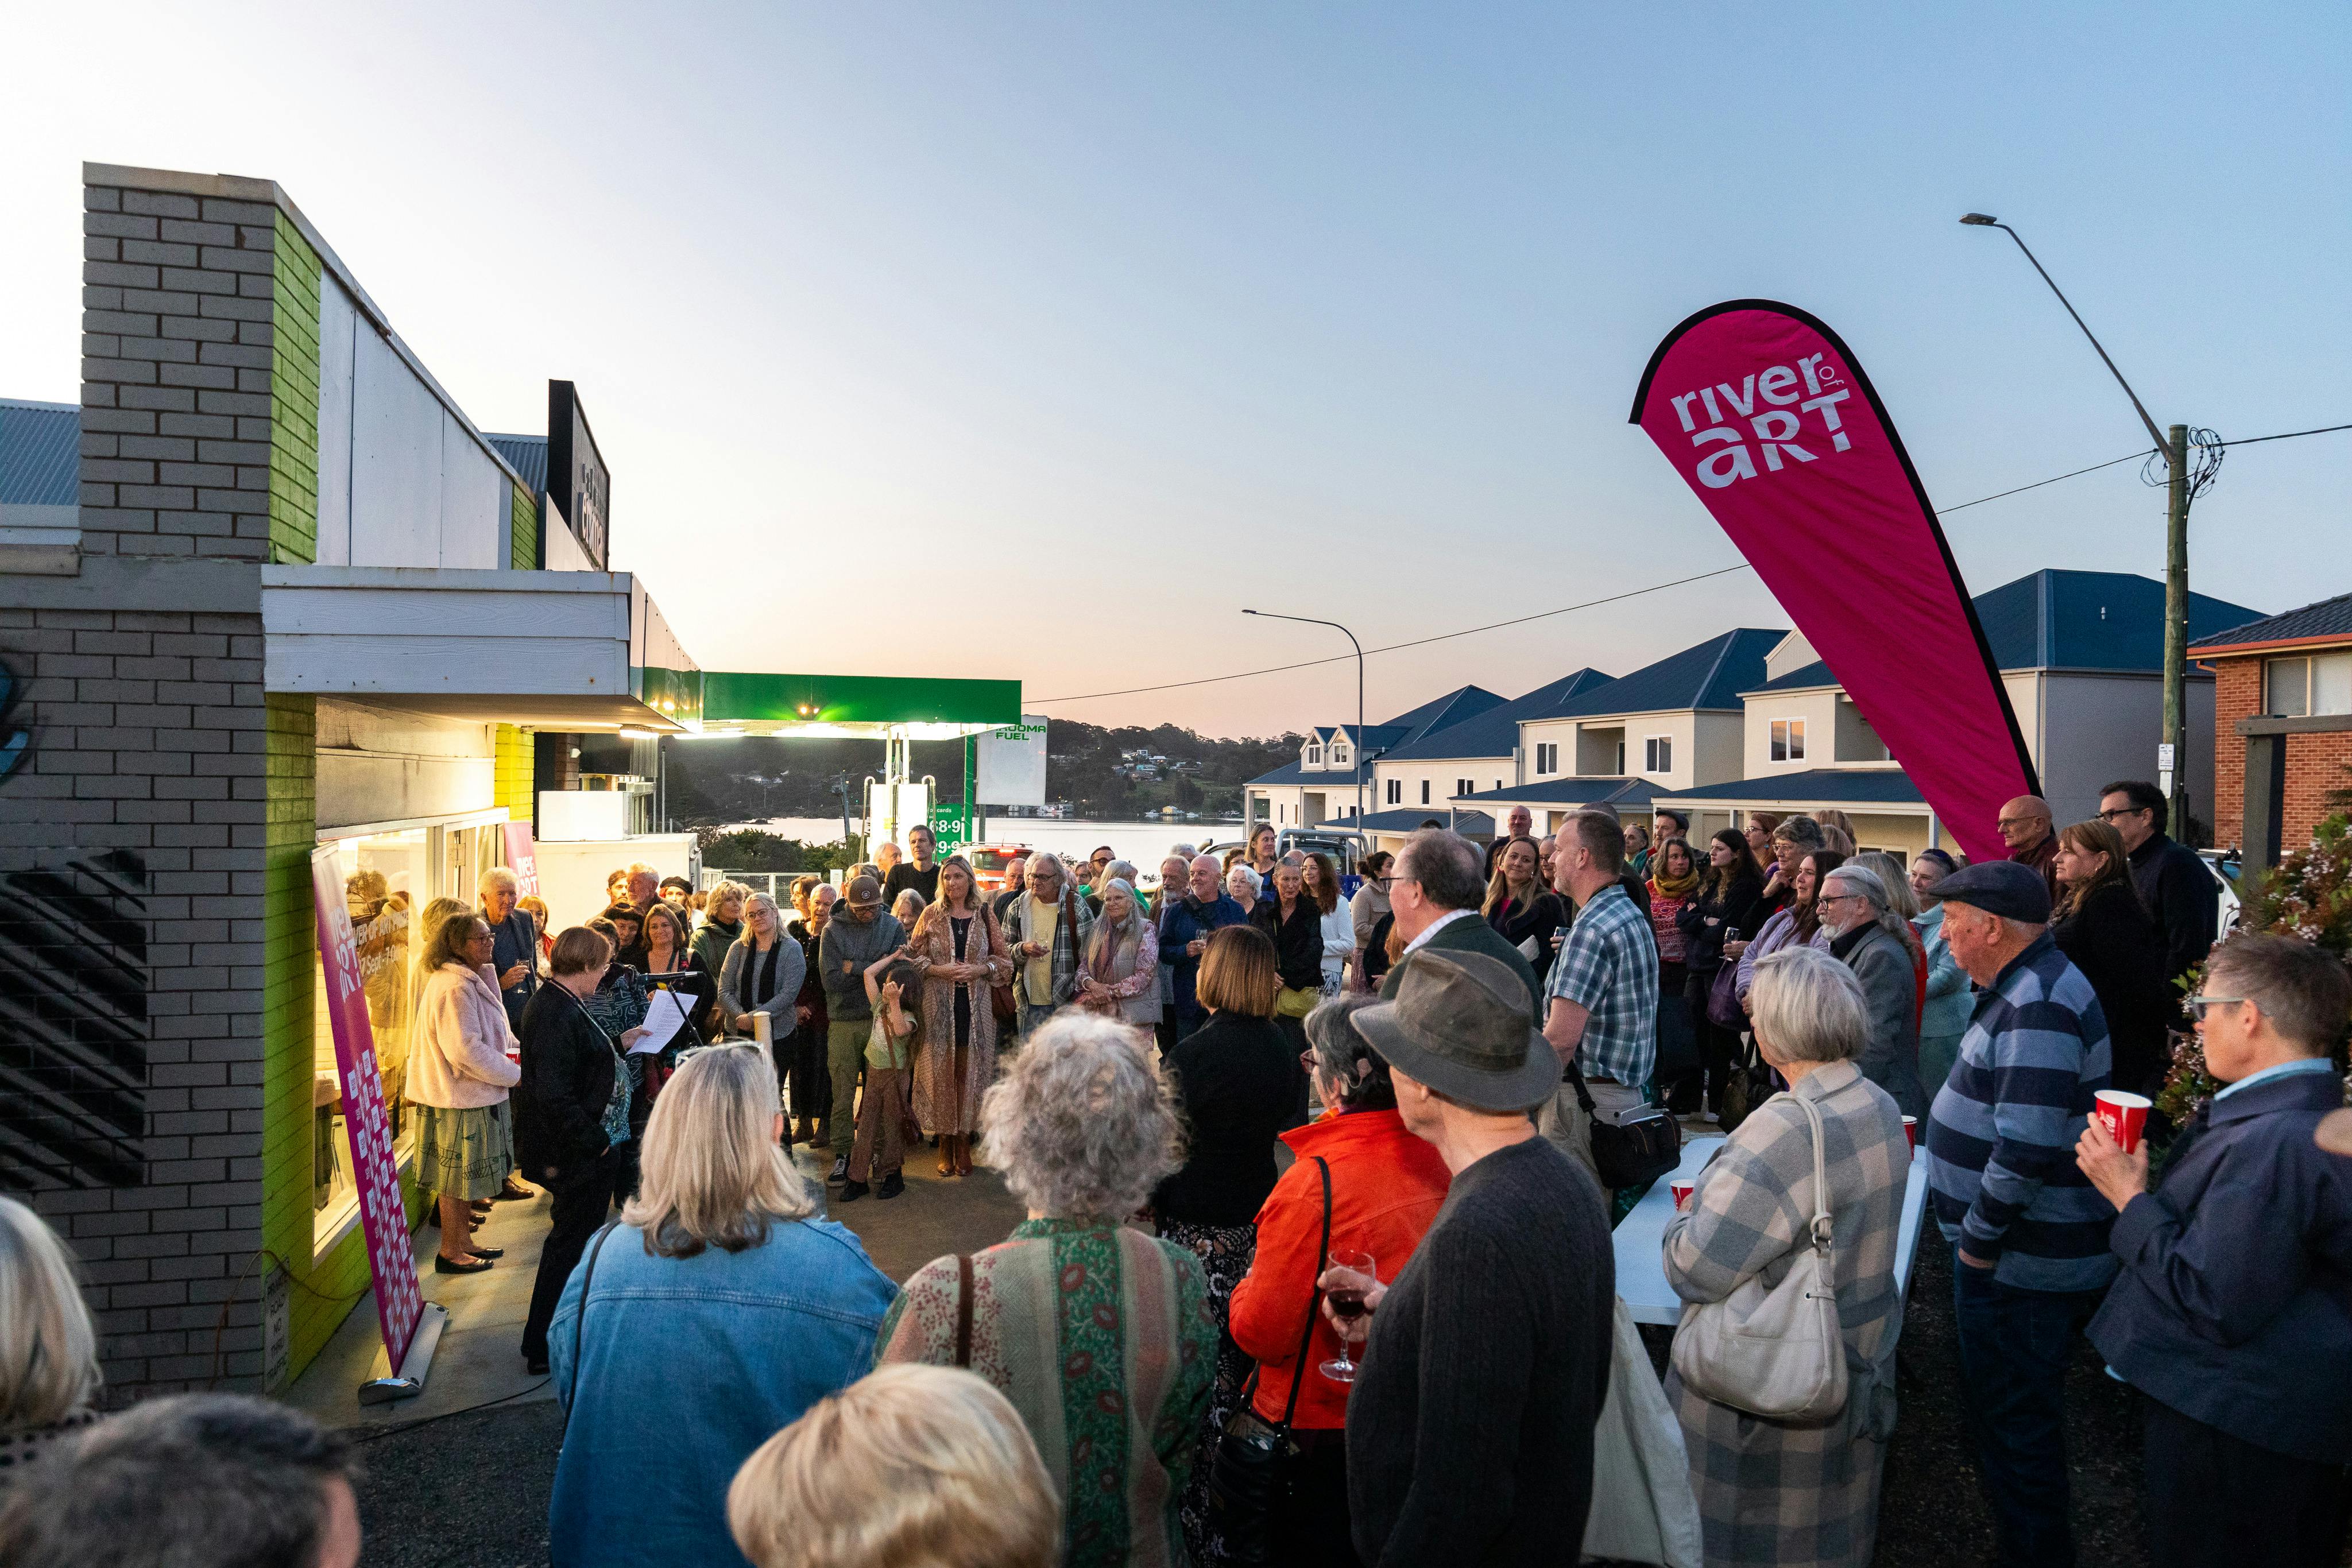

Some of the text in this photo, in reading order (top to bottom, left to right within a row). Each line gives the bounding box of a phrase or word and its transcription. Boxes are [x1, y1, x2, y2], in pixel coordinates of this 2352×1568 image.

[1819, 366, 1845, 388] of
[1670, 352, 1823, 433] river
[996, 725, 1046, 733] OOMA
[996, 732, 1030, 741] FUEL
[353, 923, 368, 947] VER
